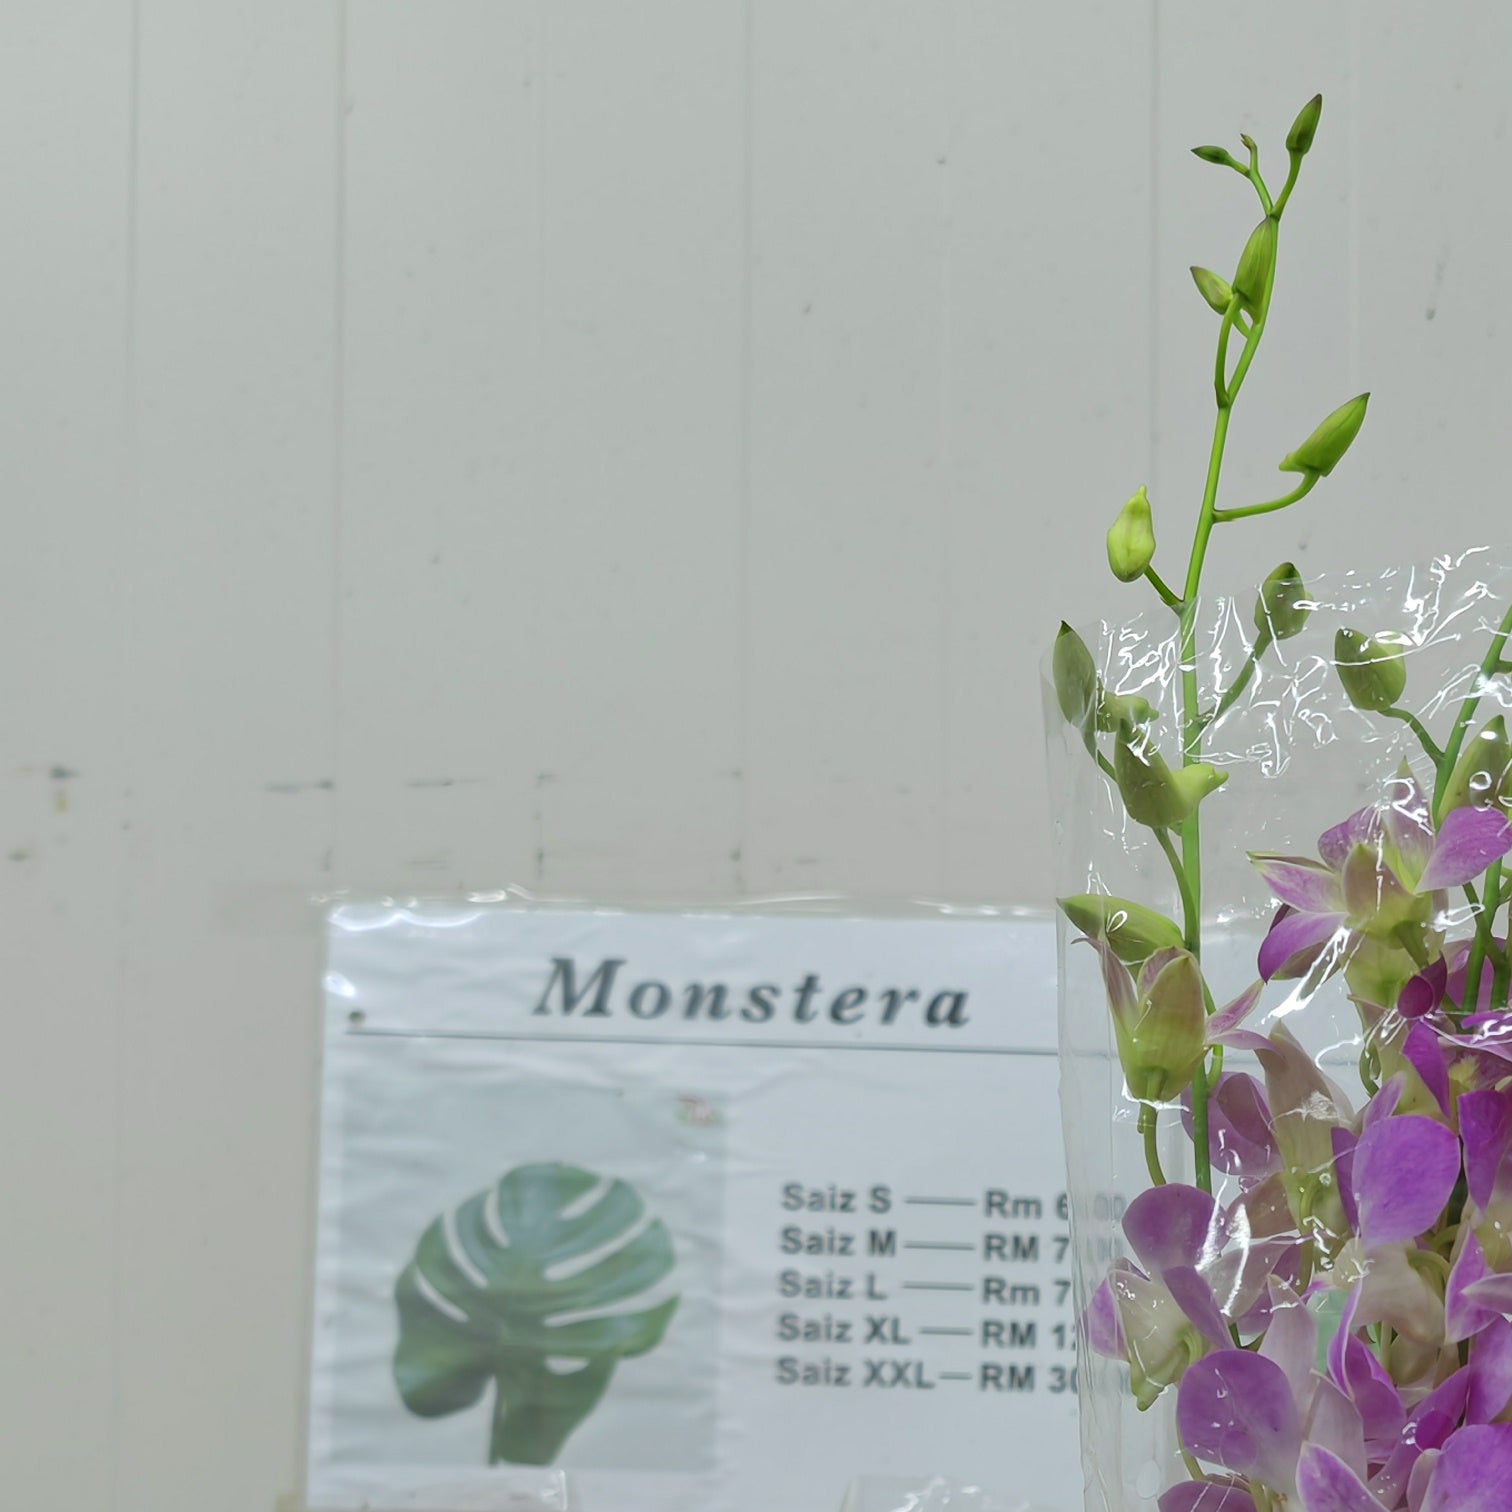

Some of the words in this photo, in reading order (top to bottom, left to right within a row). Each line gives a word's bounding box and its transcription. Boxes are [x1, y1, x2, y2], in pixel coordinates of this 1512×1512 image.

[531, 956, 970, 1027] Monstera
[781, 1182, 857, 1213] Saiz
[868, 1185, 892, 1214] S
[984, 1189, 1043, 1219] Rm
[780, 1226, 855, 1255] Saiz
[867, 1229, 896, 1257] M
[983, 1234, 1039, 1262] RM
[779, 1269, 853, 1299] Saiz
[866, 1273, 887, 1301] L
[982, 1277, 1041, 1306] Rm
[777, 1312, 852, 1342] Saiz
[864, 1316, 911, 1345] XL
[981, 1320, 1037, 1350] RM
[776, 1357, 852, 1387] Saiz
[862, 1361, 935, 1390] XXL
[979, 1363, 1035, 1393] RM
